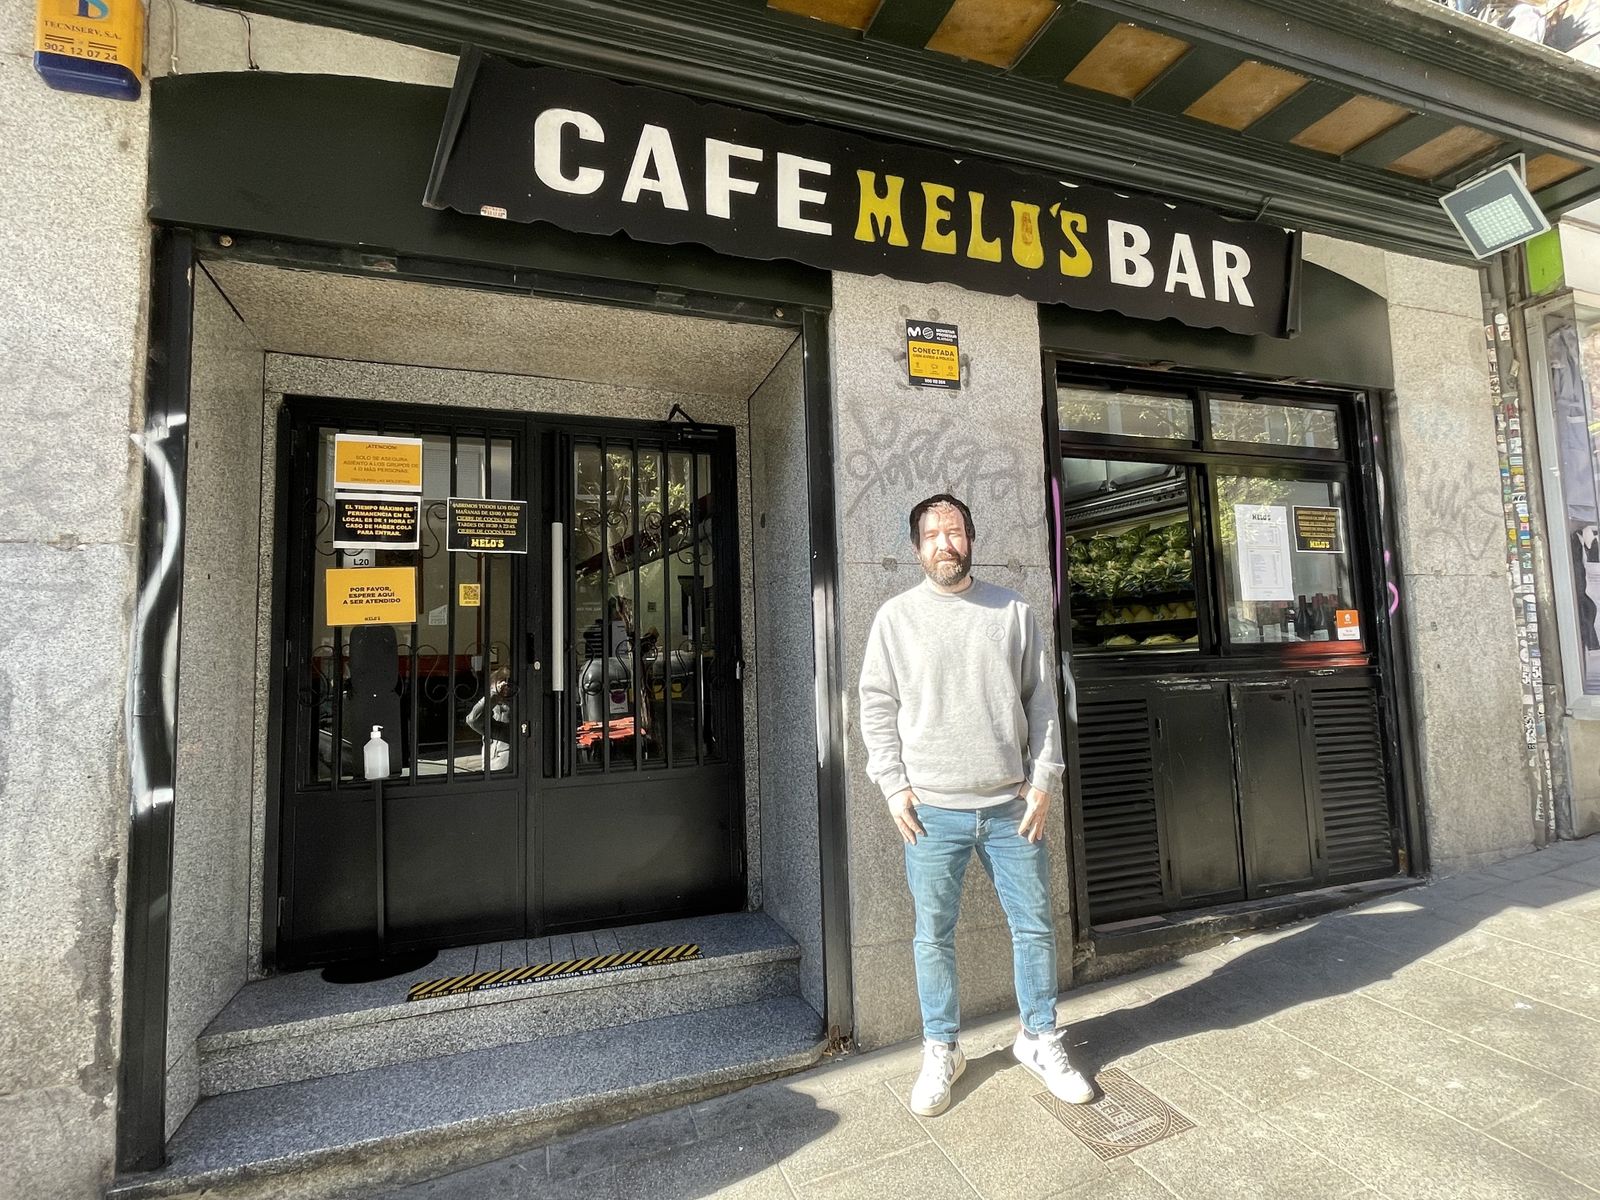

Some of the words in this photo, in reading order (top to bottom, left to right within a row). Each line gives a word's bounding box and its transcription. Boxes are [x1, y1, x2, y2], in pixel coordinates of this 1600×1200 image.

[44, 20, 103, 37] TECNISERV,
[104, 31, 121, 40] S.A.
[44, 42, 65, 53] 902
[71, 47, 83, 56] 12
[87, 49, 101, 58] 07
[105, 51, 118, 61] 24
[534, 108, 832, 236] CAFE
[1108, 219, 1255, 307] BAR
[912, 346, 955, 357] CONECTADA
[379, 504, 404, 512] MÁXIMO
[471, 538, 505, 548] MELO'S
[353, 558, 370, 566] L20
[412, 989, 449, 1001] ESPERE
[478, 979, 519, 990] RESPETE
[534, 972, 580, 983] DISTANCIA
[596, 962, 643, 974] SEGURIDAD
[647, 956, 678, 966] ESPERE
